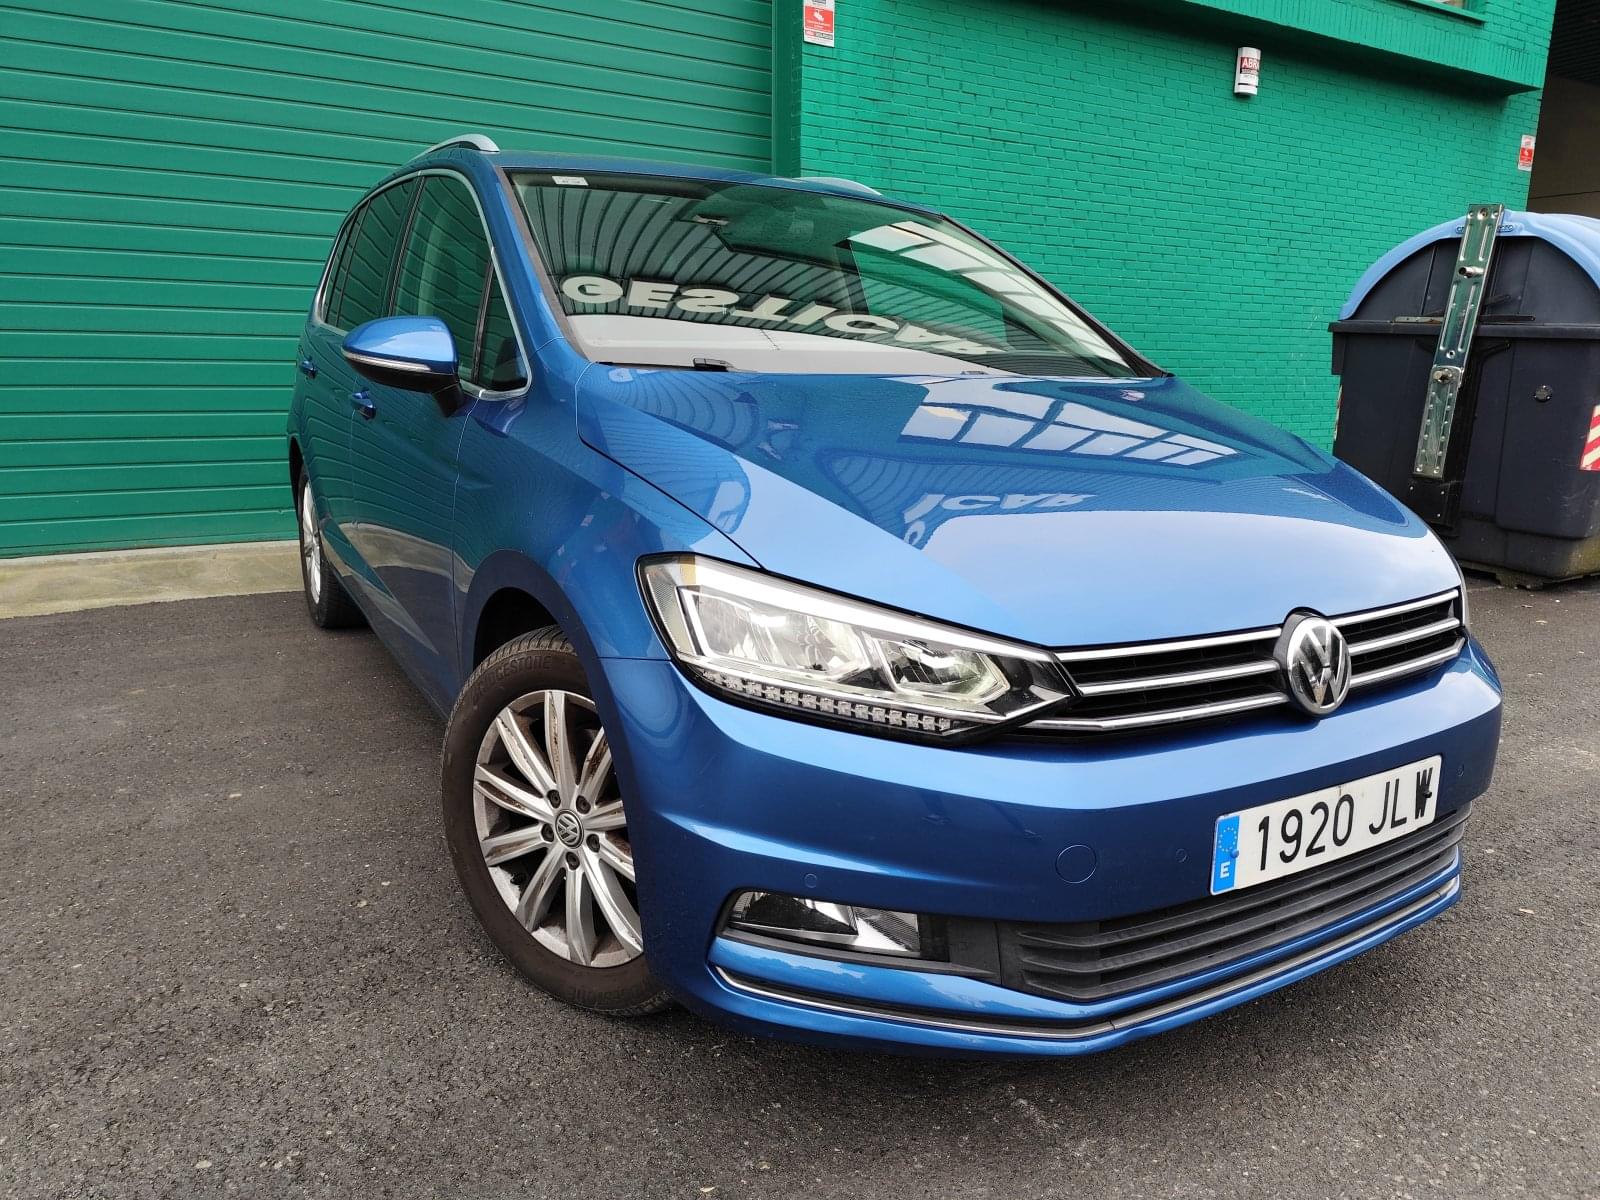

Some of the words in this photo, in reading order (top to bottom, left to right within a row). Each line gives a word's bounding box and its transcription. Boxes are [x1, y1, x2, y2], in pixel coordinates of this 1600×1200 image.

[1258, 794, 1355, 871] 1920
[1368, 767, 1434, 835] JLW
[1219, 861, 1231, 879] E
